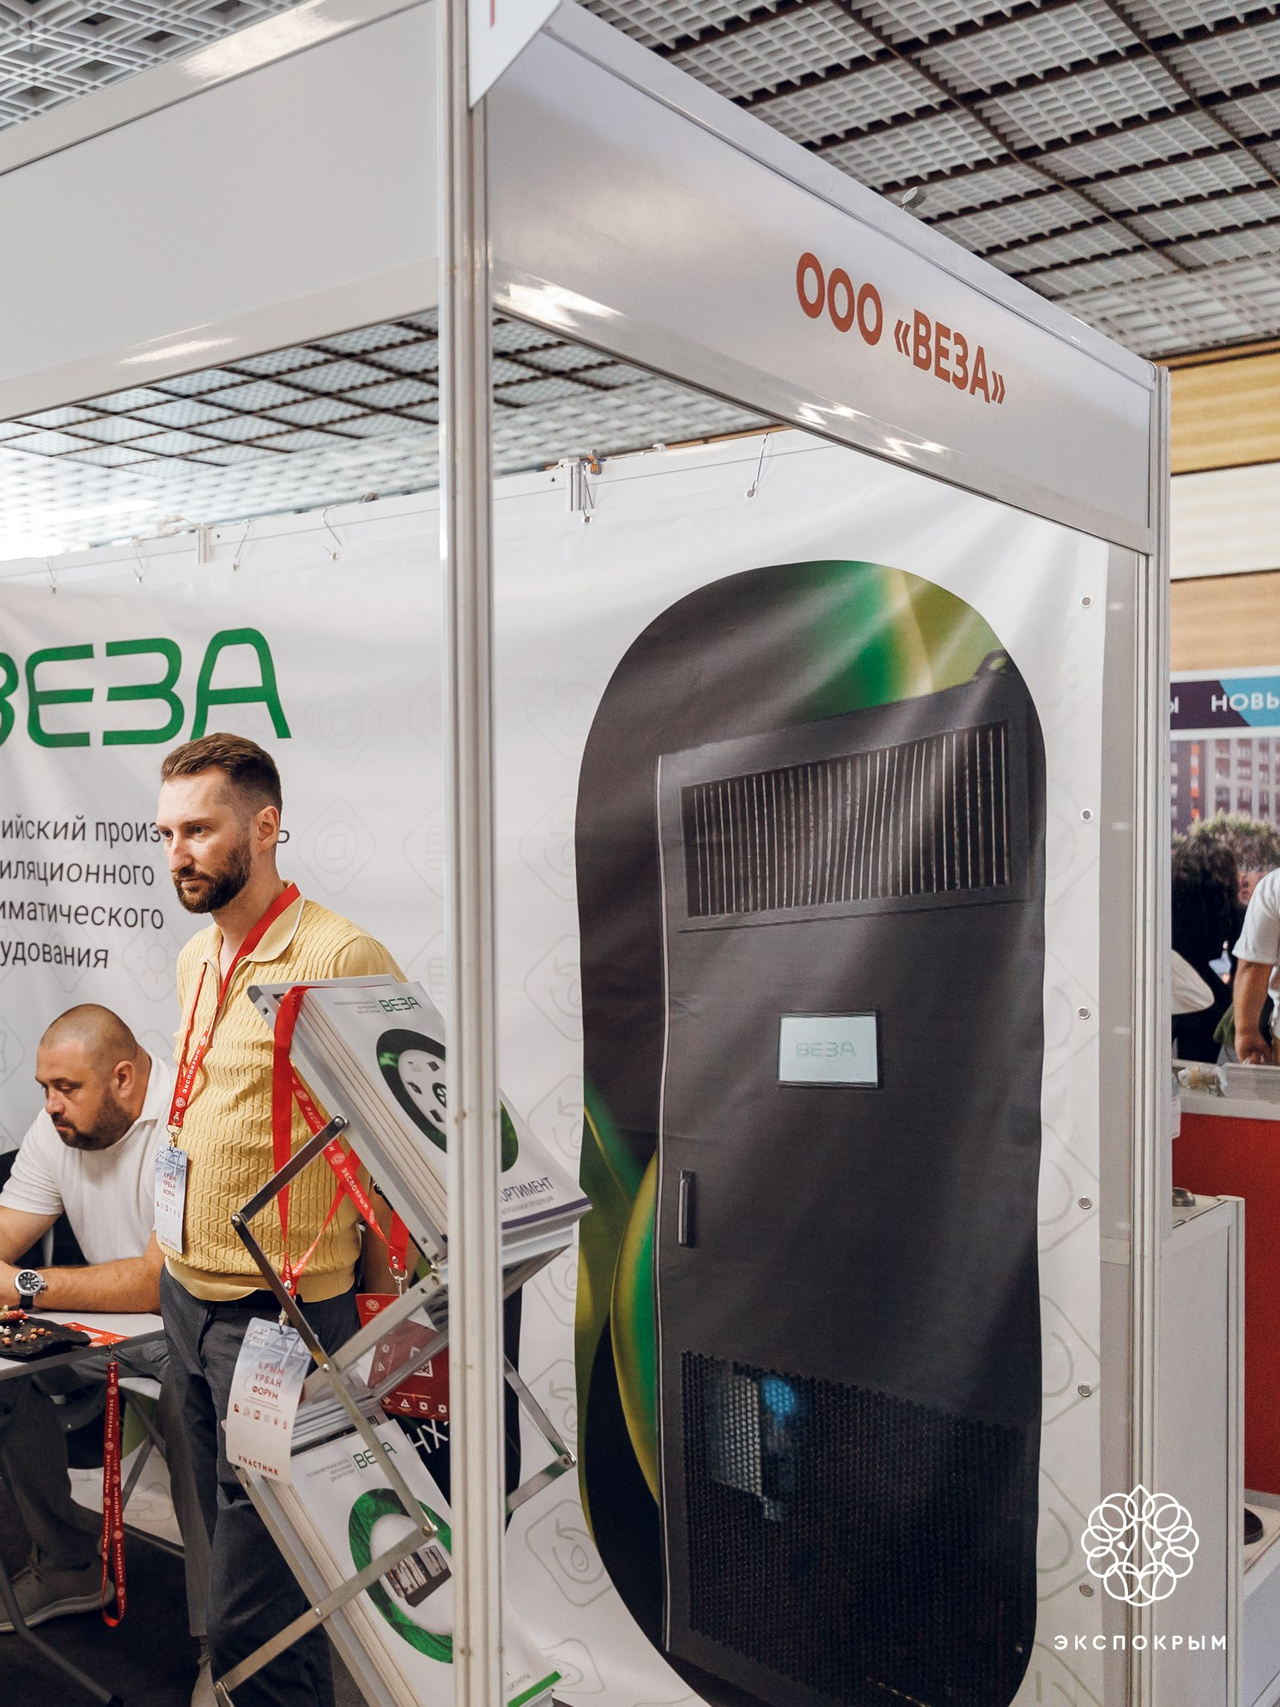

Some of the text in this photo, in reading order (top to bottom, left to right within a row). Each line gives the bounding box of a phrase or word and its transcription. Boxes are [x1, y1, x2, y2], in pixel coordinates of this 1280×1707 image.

[796, 252, 1006, 404] ООО «ВЕЗА»
[378, 996, 422, 1012] ВЕЗА
[258, 1361, 285, 1376] КРЫМ
[254, 1373, 282, 1388] УРБАН
[251, 1385, 279, 1400] ФОРУМ
[353, 1441, 397, 1469] ВЕА
[237, 1454, 279, 1476] УЧАСТНИК
